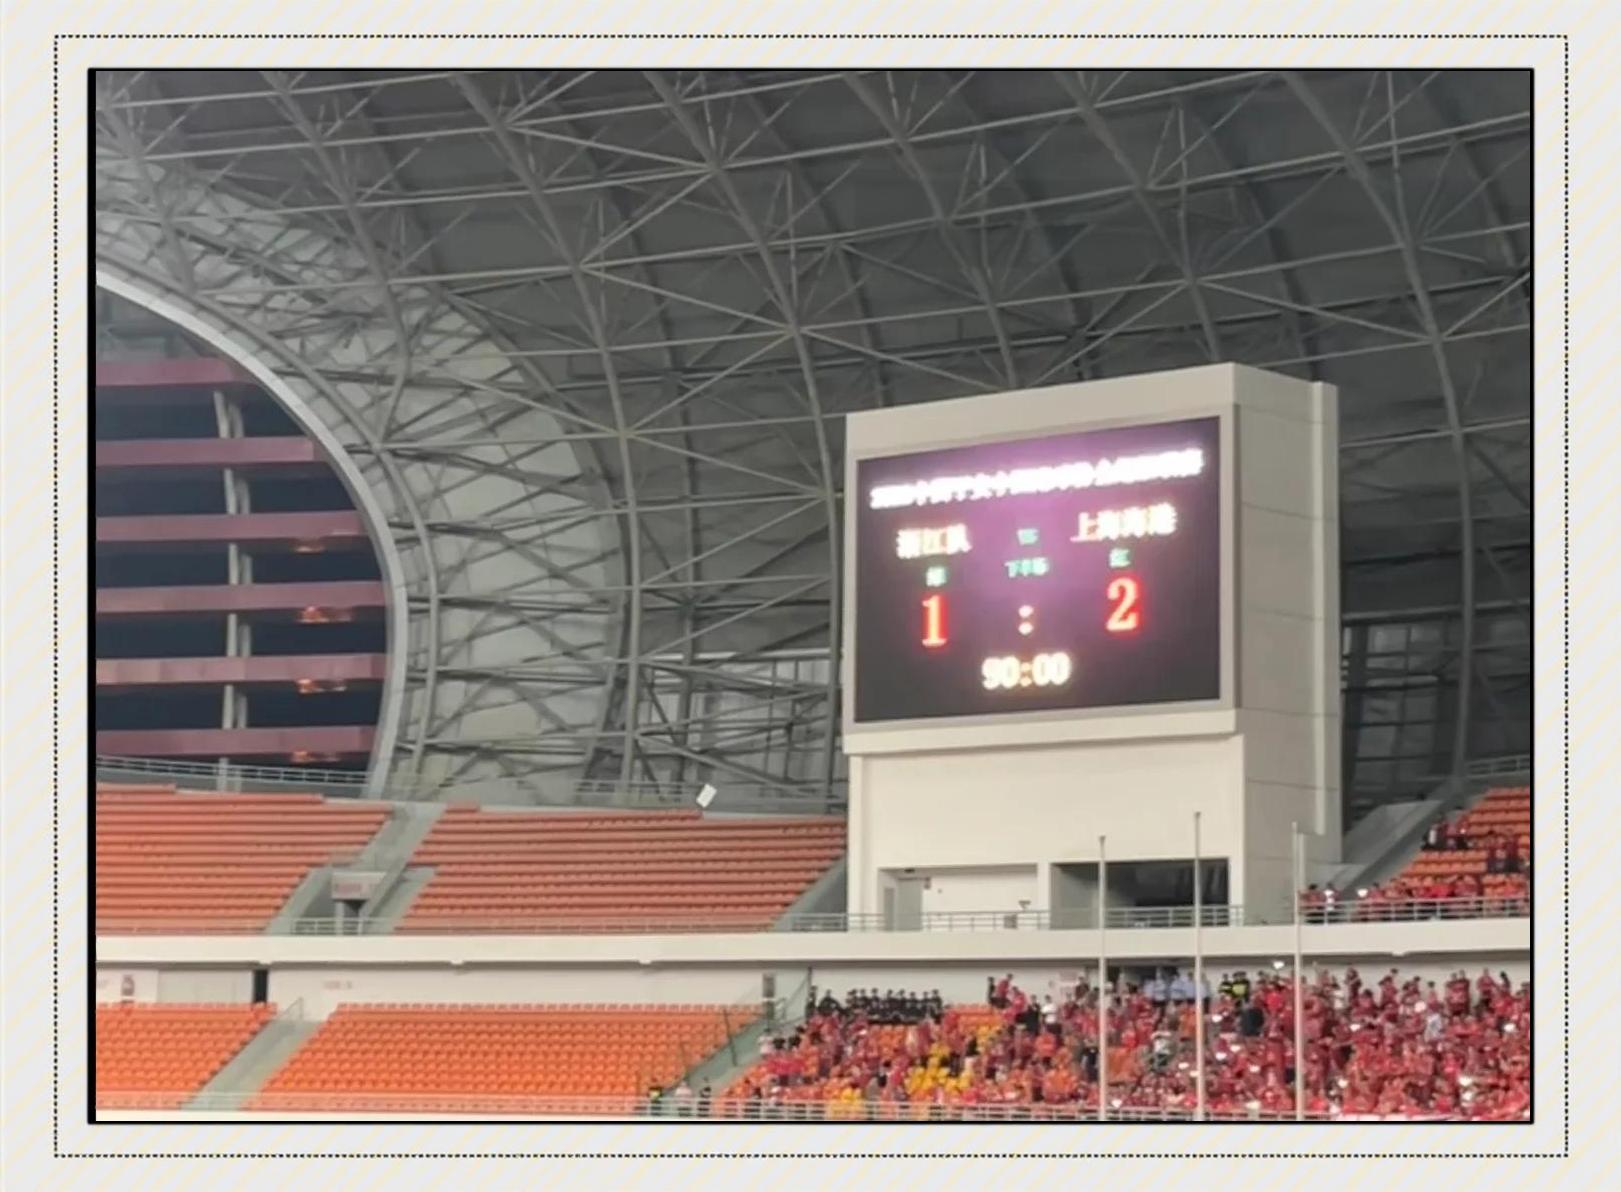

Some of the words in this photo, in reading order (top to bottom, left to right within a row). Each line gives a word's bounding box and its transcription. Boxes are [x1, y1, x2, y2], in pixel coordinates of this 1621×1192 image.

[921, 594, 947, 647] 1
[1106, 577, 1139, 632] 2
[981, 652, 1072, 690] 90:00
